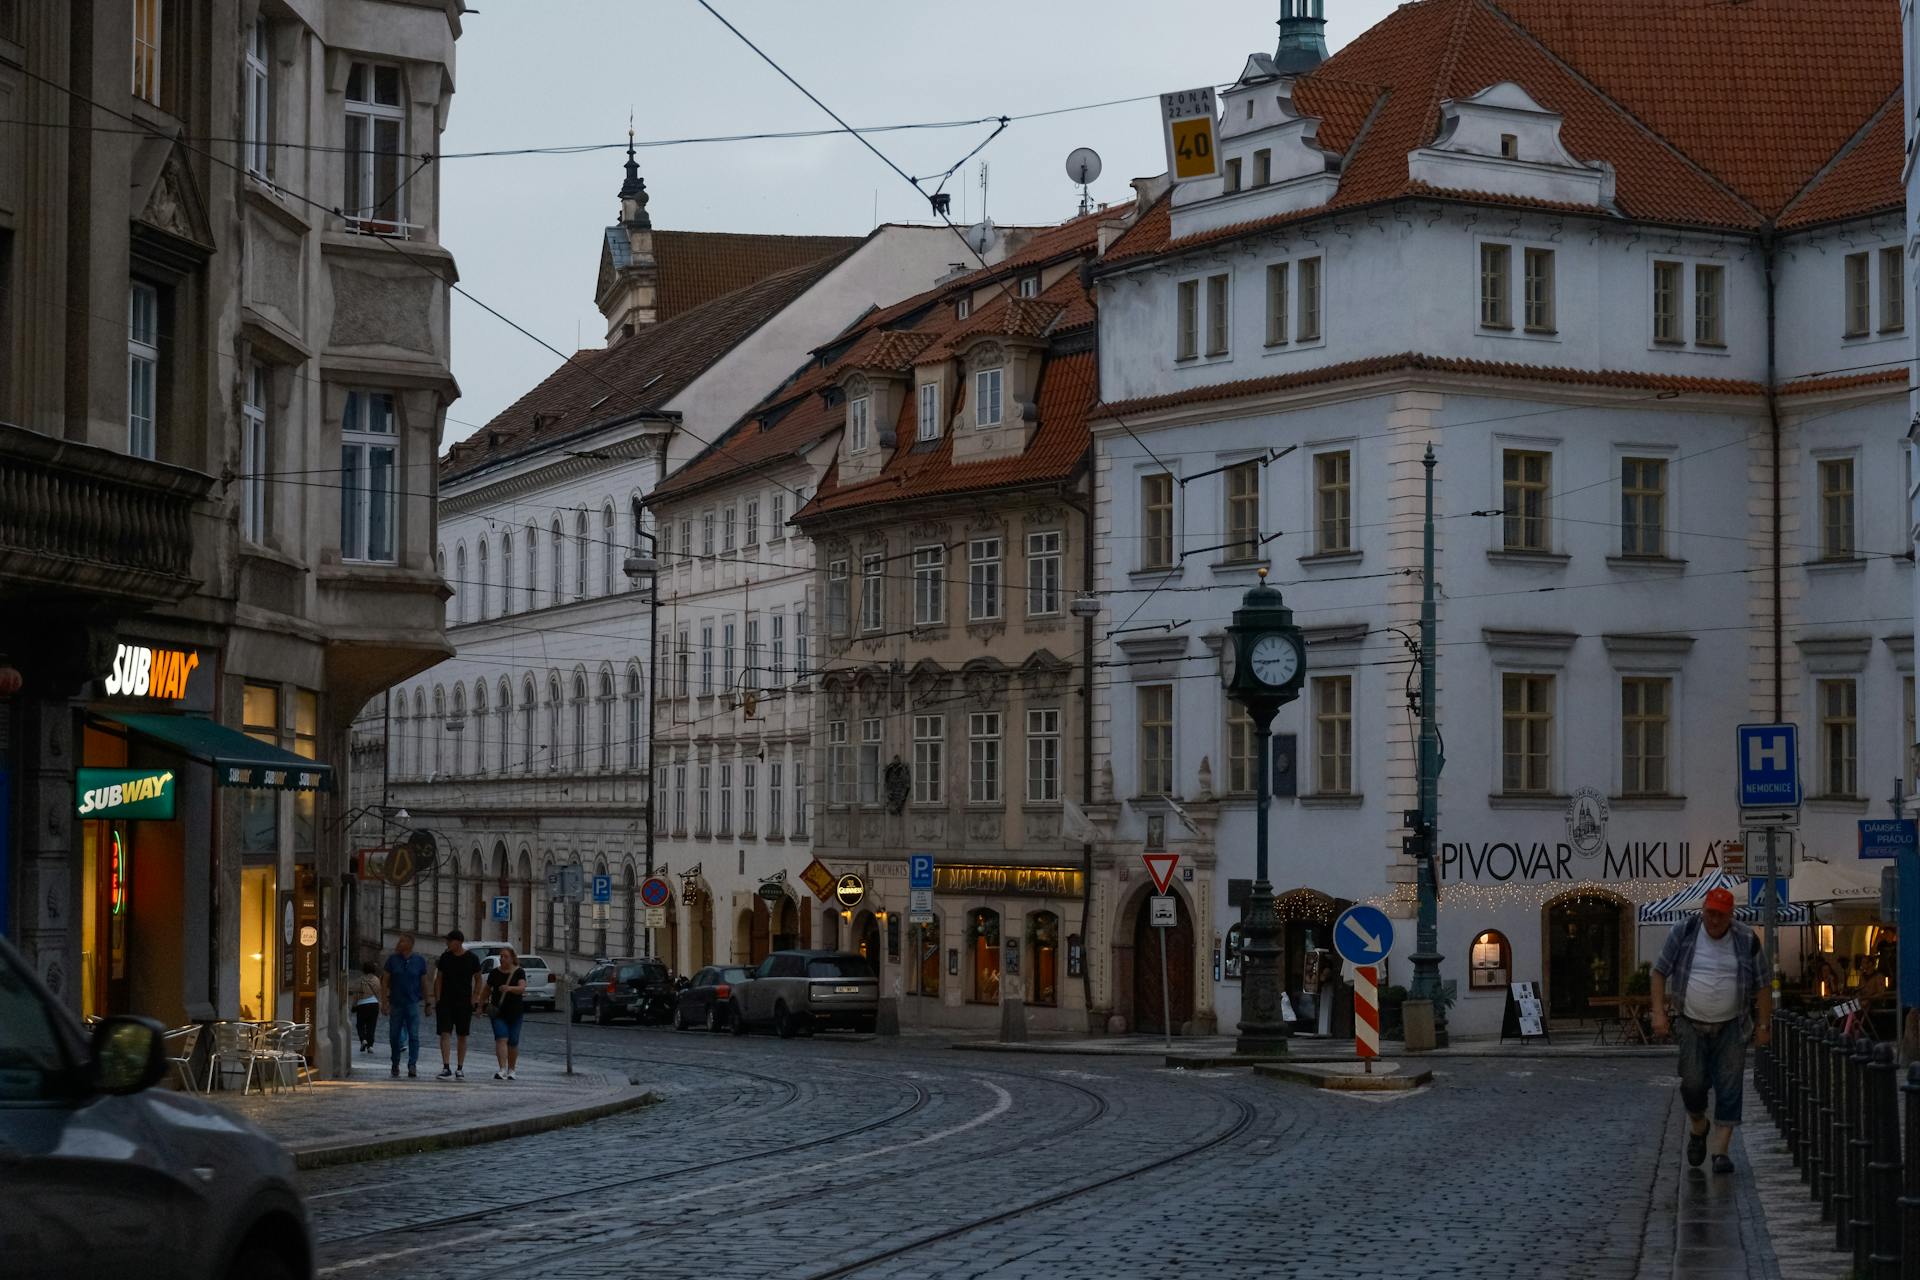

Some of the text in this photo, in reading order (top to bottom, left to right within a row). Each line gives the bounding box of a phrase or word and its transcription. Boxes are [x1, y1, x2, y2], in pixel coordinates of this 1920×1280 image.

[1177, 132, 1210, 160] 40
[105, 643, 199, 700] SUBWAY
[1749, 736, 1787, 771] H
[78, 771, 173, 815] SUBWAY
[1746, 783, 1792, 793] NEMOCNICE
[1441, 842, 1573, 880] PIVOVAR
[1602, 839, 1737, 879] MIKULÁ
